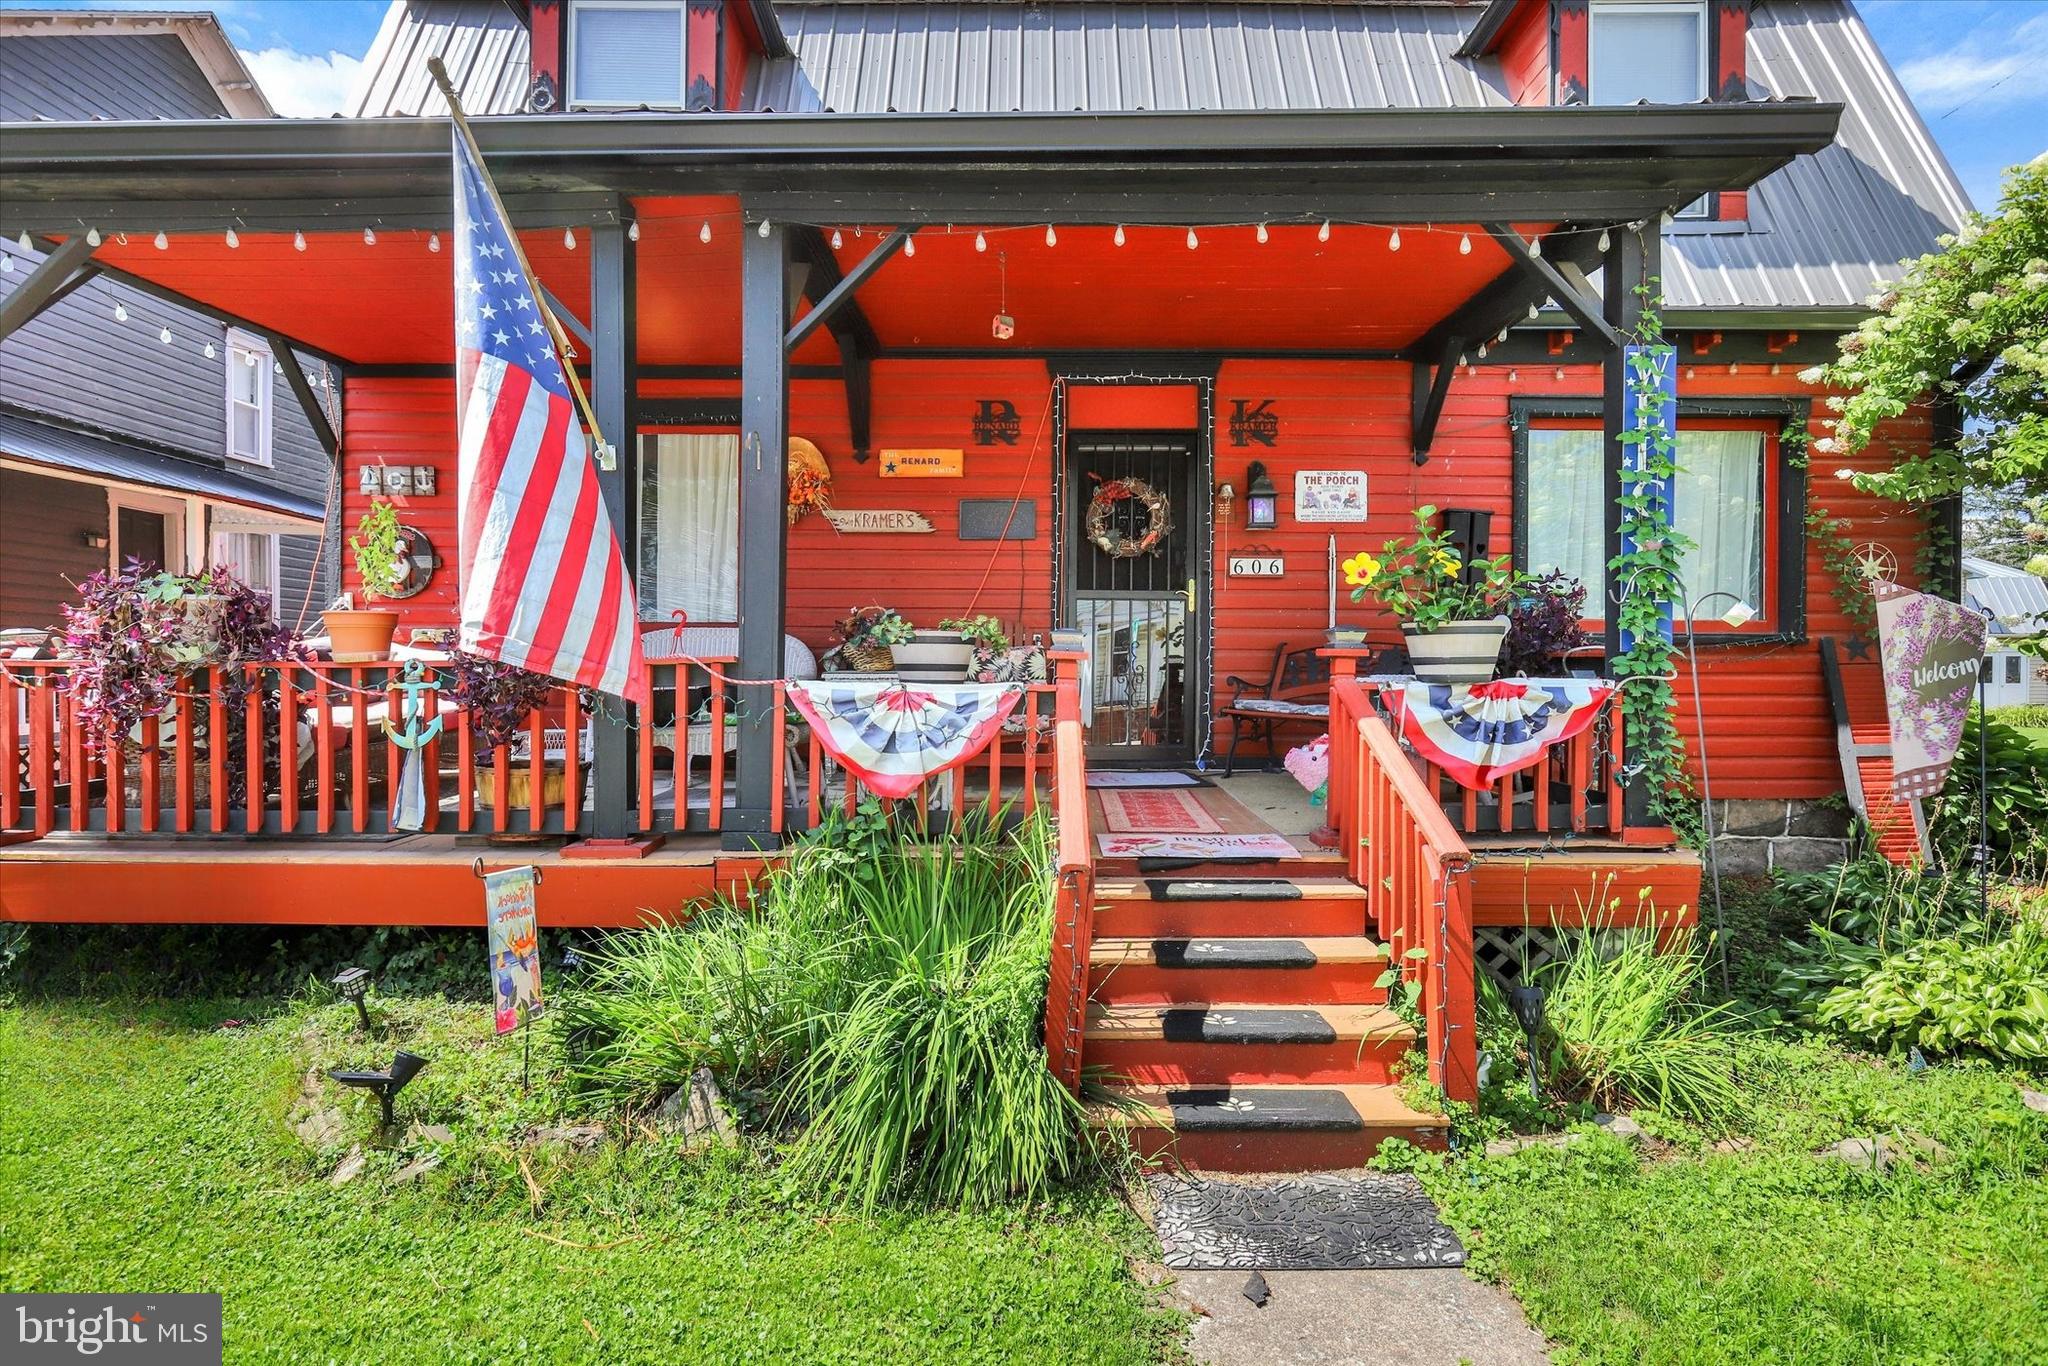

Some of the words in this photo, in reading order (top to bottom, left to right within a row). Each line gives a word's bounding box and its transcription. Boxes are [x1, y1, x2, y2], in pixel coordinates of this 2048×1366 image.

[901, 457, 941, 465] RENARD
[1304, 476, 1323, 485] THE
[1326, 476, 1359, 485] PORCH
[854, 513, 915, 528] KRAMER'S
[1234, 559, 1279, 574] 606
[1914, 657, 1980, 688] Welcom
